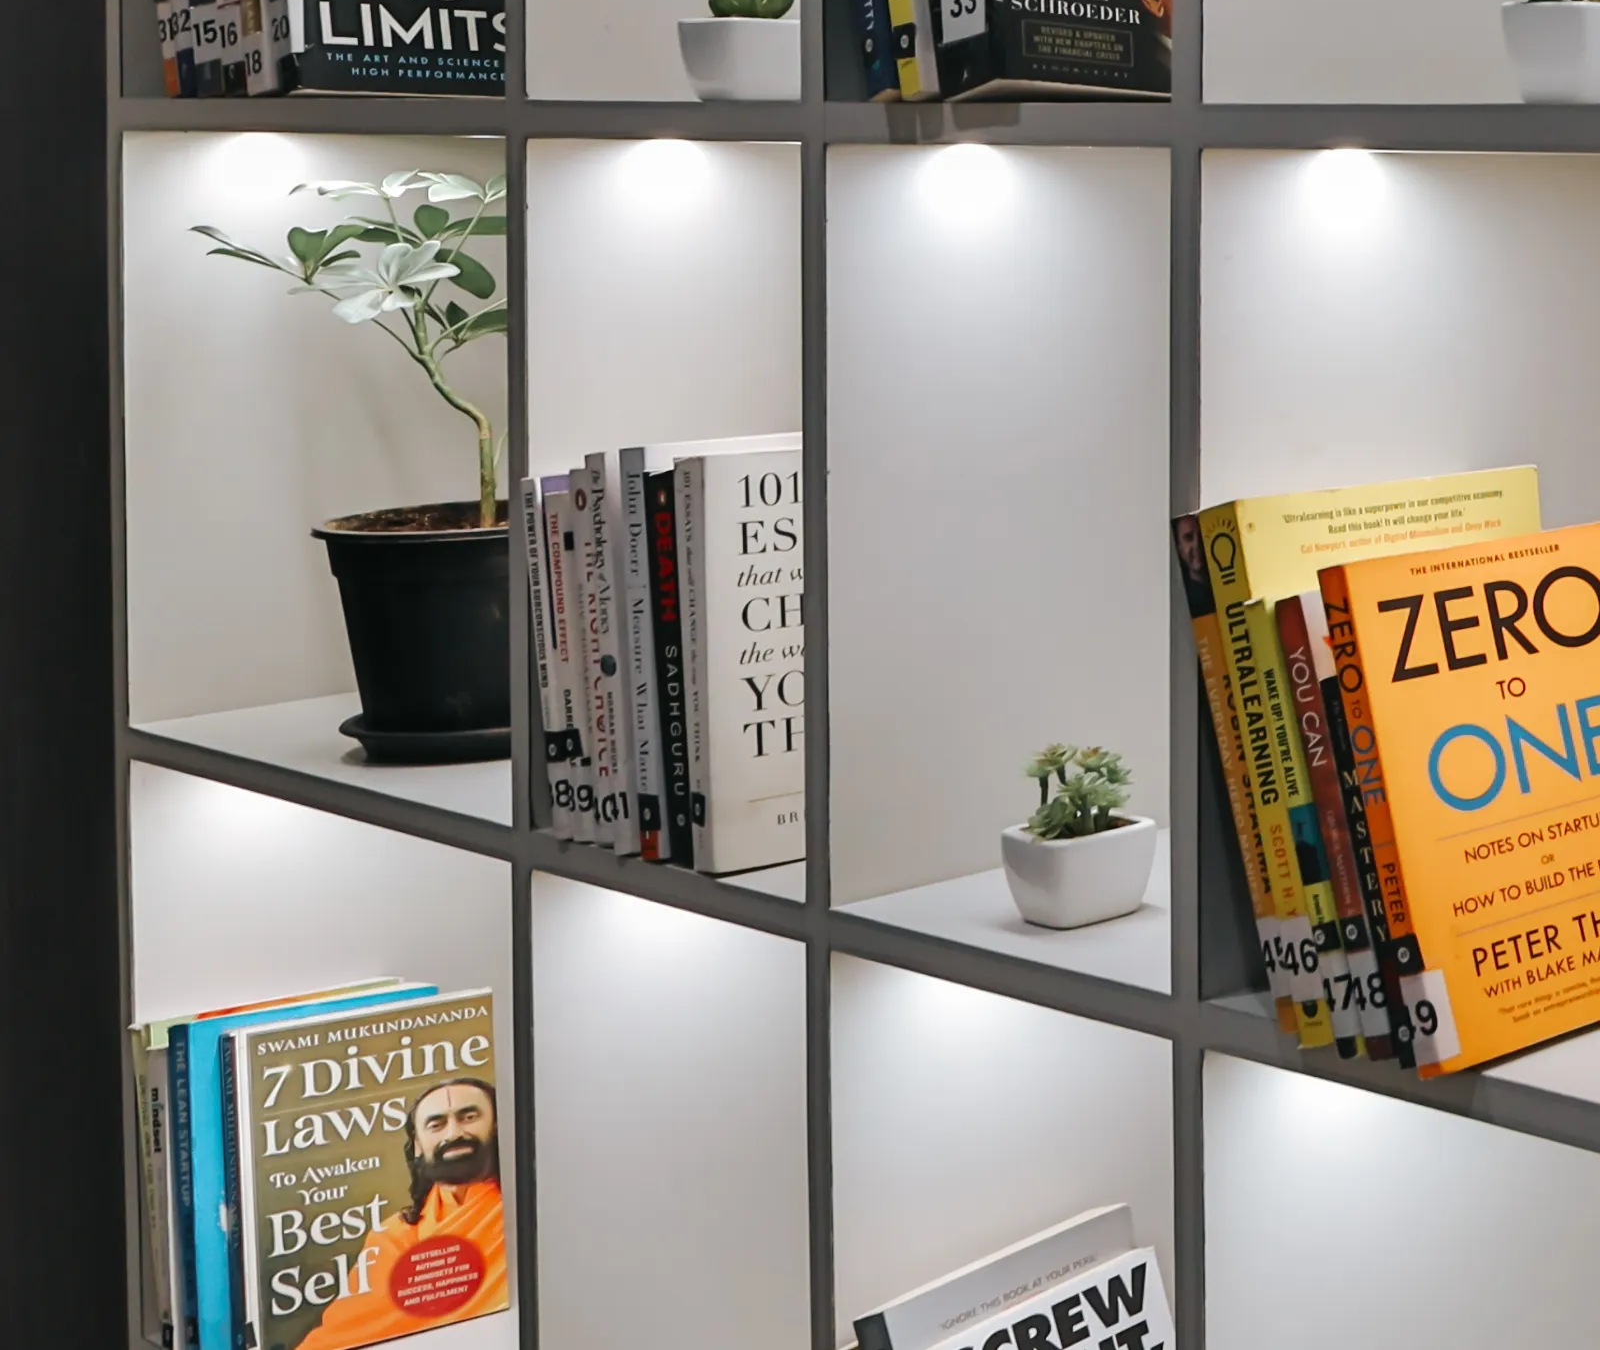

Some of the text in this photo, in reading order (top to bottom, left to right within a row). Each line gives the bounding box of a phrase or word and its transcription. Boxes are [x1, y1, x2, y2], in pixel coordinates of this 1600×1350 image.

[193, 18, 219, 47] 15
[219, 22, 239, 49] 16
[271, 14, 290, 42] 20
[245, 50, 263, 77] 18
[326, 52, 500, 68] THE ART AND SCIENCE
[351, 67, 507, 81] HIGH PERFORMANCE
[737, 471, 802, 508] 101
[737, 564, 782, 588] that
[1410, 544, 1560, 576] THE INTERNATIONAL BESTSELLER
[523, 491, 549, 688] THE POWER OF YOUR SUBCONSCIOUS MIND
[548, 512, 570, 663] THE COMPOUND EFFECT
[625, 470, 650, 730] John Doerr Measure What
[651, 511, 690, 796] DEATH SADHGURU
[739, 641, 774, 665] the
[1284, 646, 1330, 766] YOU CAN
[1496, 676, 1526, 700] TO
[1196, 636, 1247, 828] THE EVERYDAY HERO
[1223, 600, 1292, 879] ULTRALEARNING SCOTT
[1261, 668, 1300, 798] WAKE UP! YOU'RE ALIVE
[1322, 595, 1406, 925] ZERO TO ONE PETER
[1464, 836, 1515, 864] NOTES
[1517, 829, 1544, 848] ON
[1540, 853, 1555, 865] OR
[1452, 891, 1495, 918] HOW
[1499, 884, 1521, 903] TO
[1525, 871, 1565, 895] BUILD
[1568, 862, 1595, 883] THE
[1472, 924, 1562, 978] PETER
[1483, 977, 1522, 999] WITH
[1526, 955, 1576, 986] BLAKE
[257, 1006, 488, 1056] SWAMI MUKUNDANANDA
[263, 1033, 491, 1108] 7 Divine
[149, 1087, 166, 1152] mindset
[173, 1041, 193, 1206] THE LEAN STARTUP
[260, 1096, 408, 1158] Laws
[269, 1156, 380, 1189] To Awaken
[297, 1185, 349, 1205] Your
[266, 1193, 389, 1258] Best
[410, 1244, 461, 1262] BESTSELLING
[271, 1246, 380, 1316] Self
[404, 1285, 469, 1307] AND FULFILMENT
[980, 1297, 1001, 1312] THIS
[1002, 1285, 1029, 1302] BOOK
[1031, 1277, 1044, 1290] AT
[1045, 1265, 1071, 1282] YOUR
